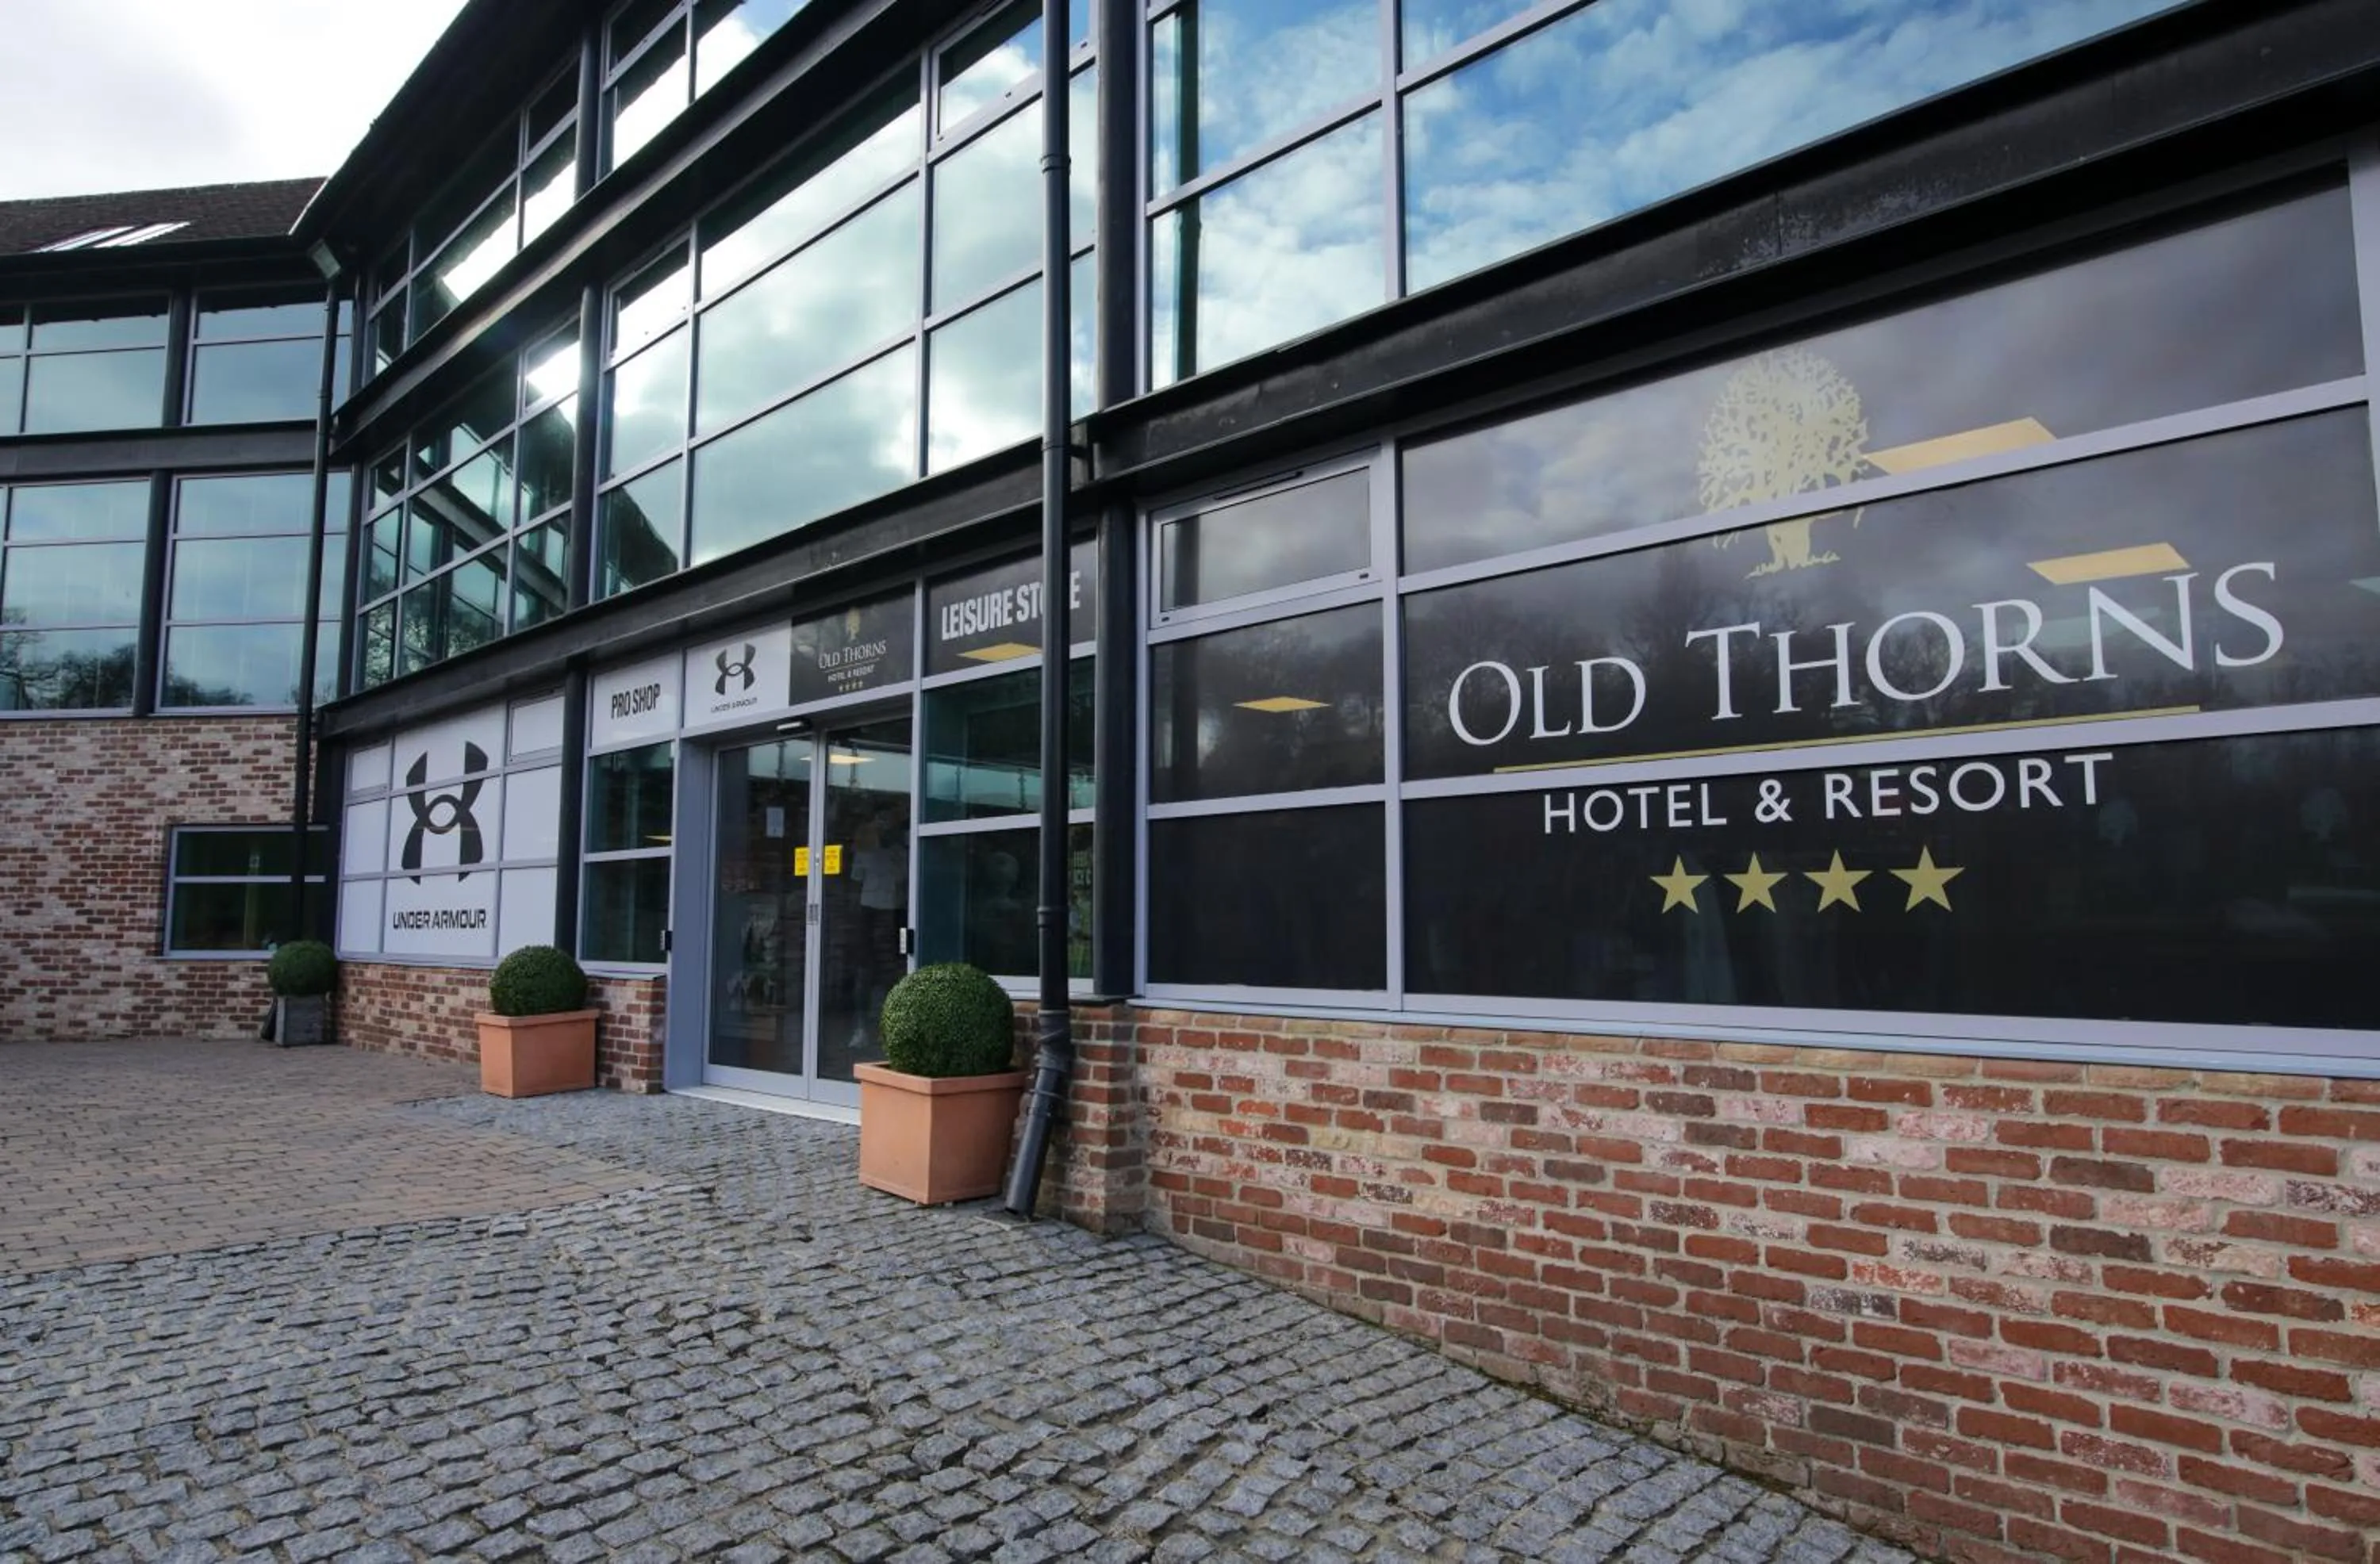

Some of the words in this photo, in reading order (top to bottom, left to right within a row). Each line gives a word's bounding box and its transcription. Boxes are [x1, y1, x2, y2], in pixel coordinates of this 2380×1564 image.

[942, 588, 1013, 641] LEISURE
[1016, 570, 1080, 623] STE
[819, 651, 840, 669] OLD
[843, 640, 886, 663] THORNS
[1449, 657, 1646, 746] OLD
[1685, 562, 2285, 721] THORNS
[611, 691, 631, 719] PRO
[633, 683, 660, 715] SHOP
[1545, 781, 1727, 834] HOTEL
[1754, 779, 1791, 823] &
[1825, 753, 2113, 820] RESORT
[393, 911, 430, 930] UNDER
[432, 909, 486, 930] ARMOUR
